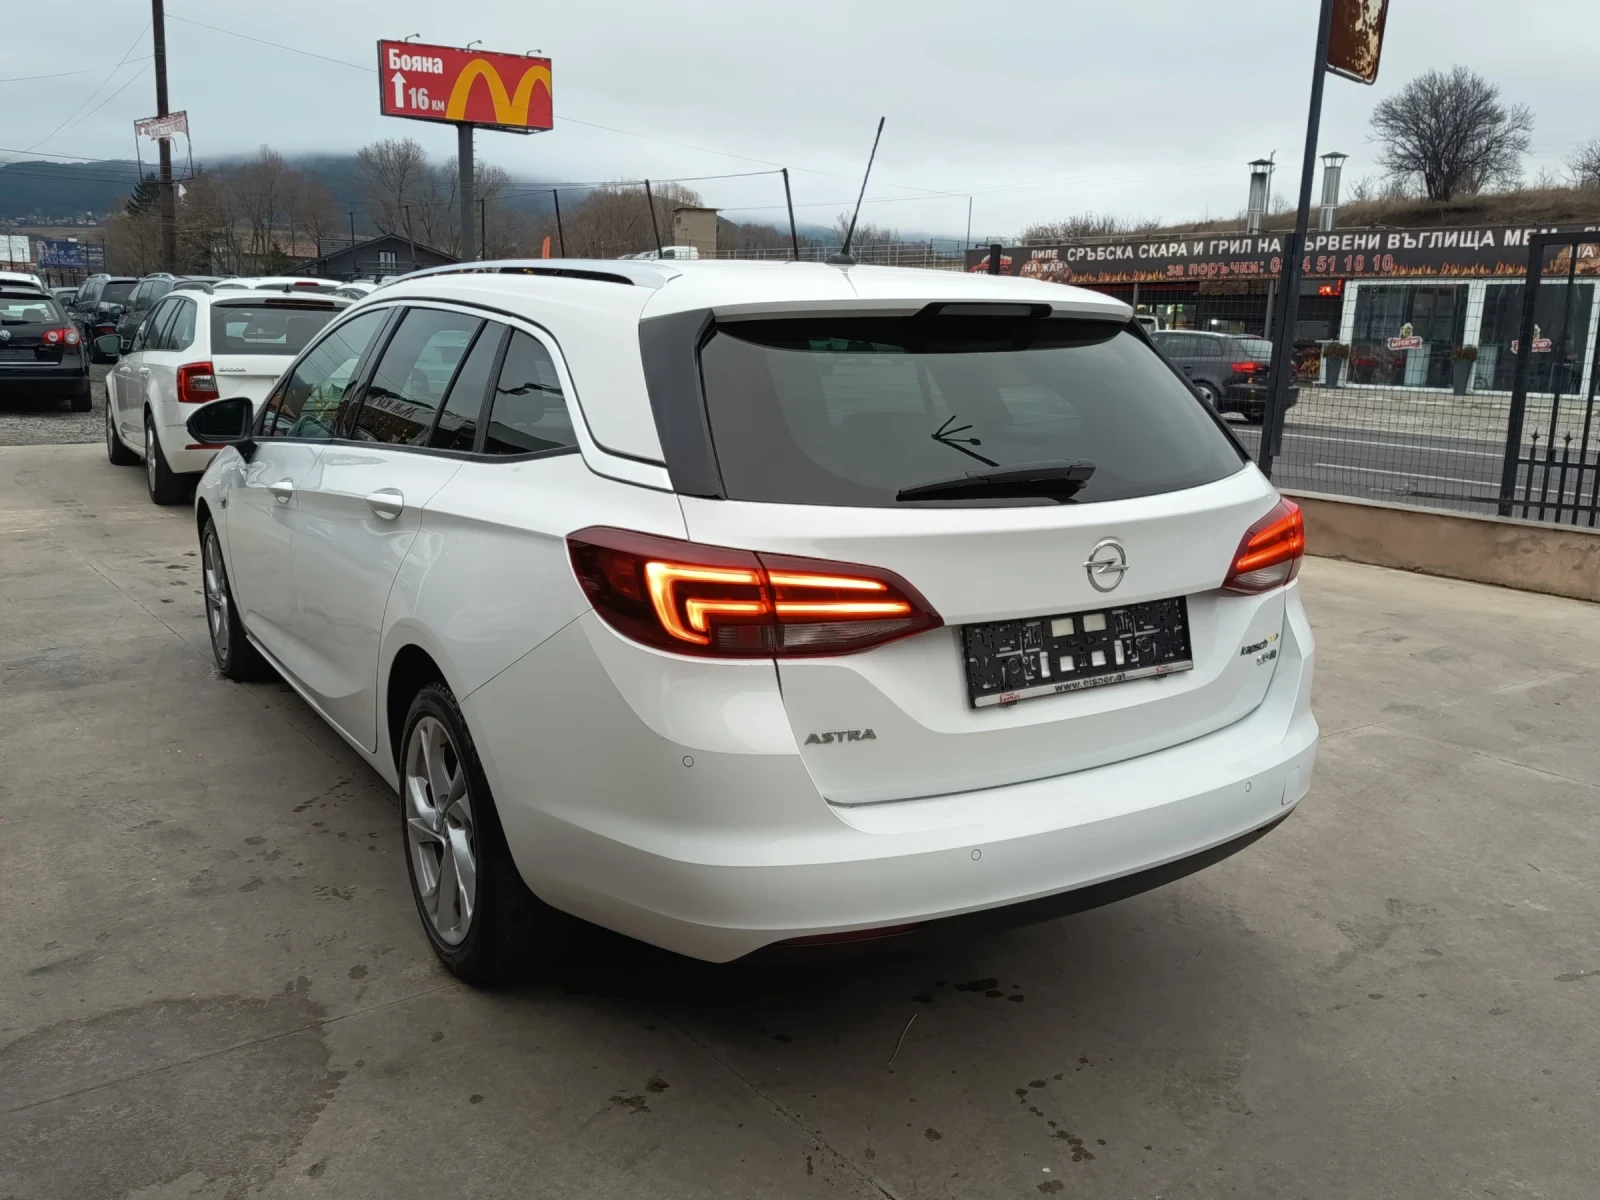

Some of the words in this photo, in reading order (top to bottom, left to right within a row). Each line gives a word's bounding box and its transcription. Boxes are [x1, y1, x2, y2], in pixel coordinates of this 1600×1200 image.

[388, 48, 444, 74] Бояна
[408, 87, 430, 110] 16
[1031, 249, 1059, 260] ПИЛЕ
[1067, 245, 1134, 261] СРЪБСКА
[1138, 242, 1188, 259] СКАРА
[1193, 241, 1204, 256] И
[1209, 239, 1252, 255] ГРИЛ
[1257, 237, 1282, 253] НА
[1303, 233, 1381, 251] ЪРВЕНИ
[1387, 229, 1496, 250] ВЪГЛИЩА
[1024, 262, 1037, 273] НА
[1041, 262, 1063, 273] ЖАР
[1166, 264, 1184, 276] за
[1188, 261, 1265, 277] поръчки:
[1315, 254, 1337, 272] 51
[1343, 254, 1365, 272] 10
[1372, 253, 1394, 272] 10
[1054, 672, 1126, 692] www.eisner.at
[804, 727, 878, 746] ASTRA
